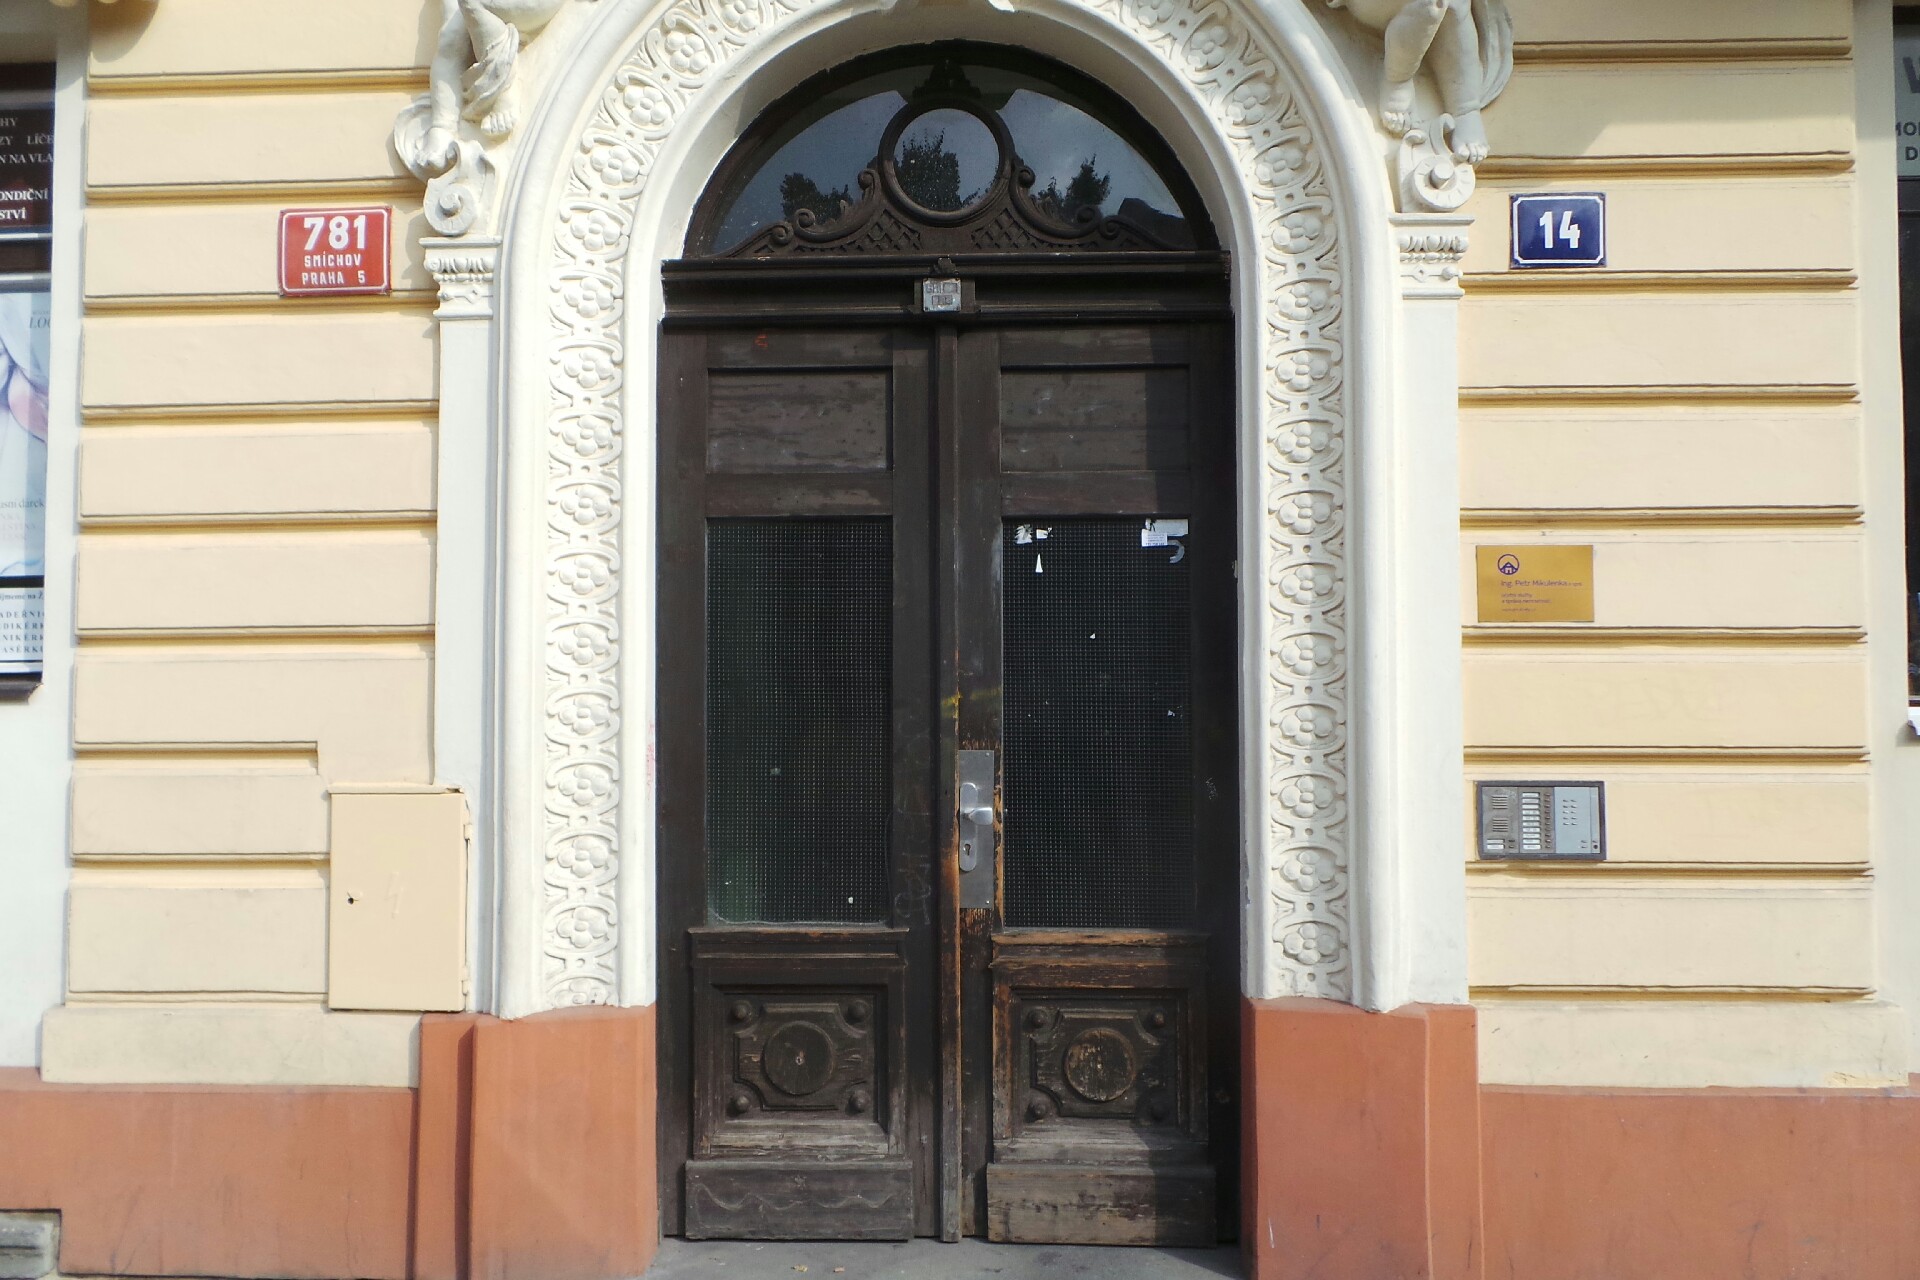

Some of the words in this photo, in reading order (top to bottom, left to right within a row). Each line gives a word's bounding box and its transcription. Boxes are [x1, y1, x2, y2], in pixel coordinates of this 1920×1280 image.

[303, 214, 366, 250] 781
[1539, 210, 1580, 249] 14
[304, 251, 361, 267] SMÍCHOV
[302, 271, 344, 285] PRAHA
[357, 270, 366, 283] 5
